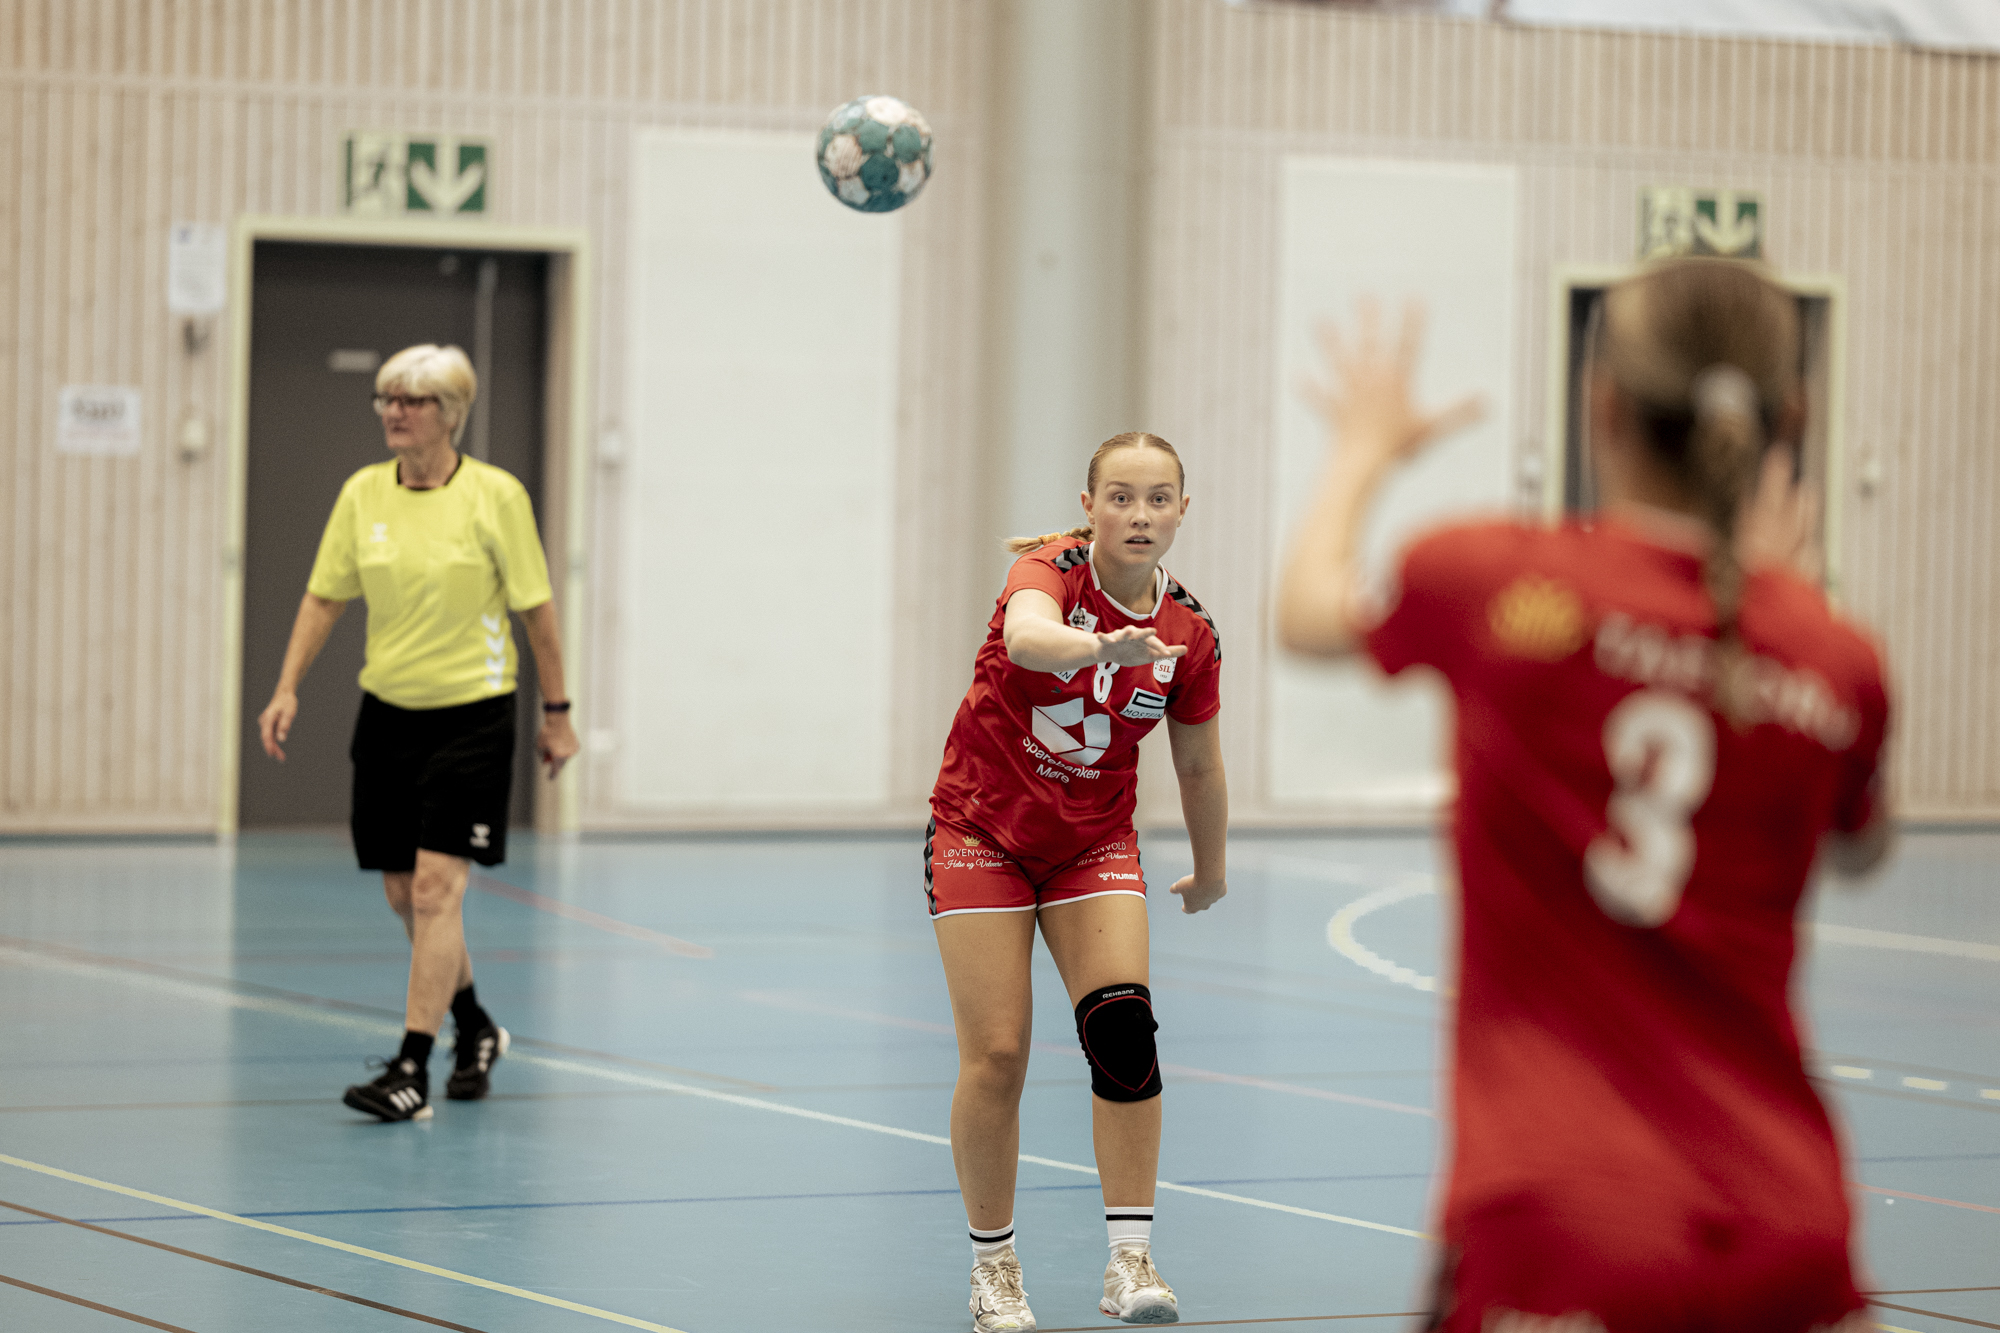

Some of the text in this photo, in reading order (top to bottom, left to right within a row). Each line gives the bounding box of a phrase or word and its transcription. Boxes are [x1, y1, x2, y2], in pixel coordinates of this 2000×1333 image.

[1158, 664, 1171, 674] SIL
[1093, 661, 1121, 704] 8
[1022, 736, 1100, 779] Sparebanken
[1036, 764, 1070, 784] Møre
[1582, 687, 1719, 929] 3
[943, 848, 1004, 859] LØVENVOLD
[966, 862, 975, 870] og
[1110, 872, 1139, 880] hummel
